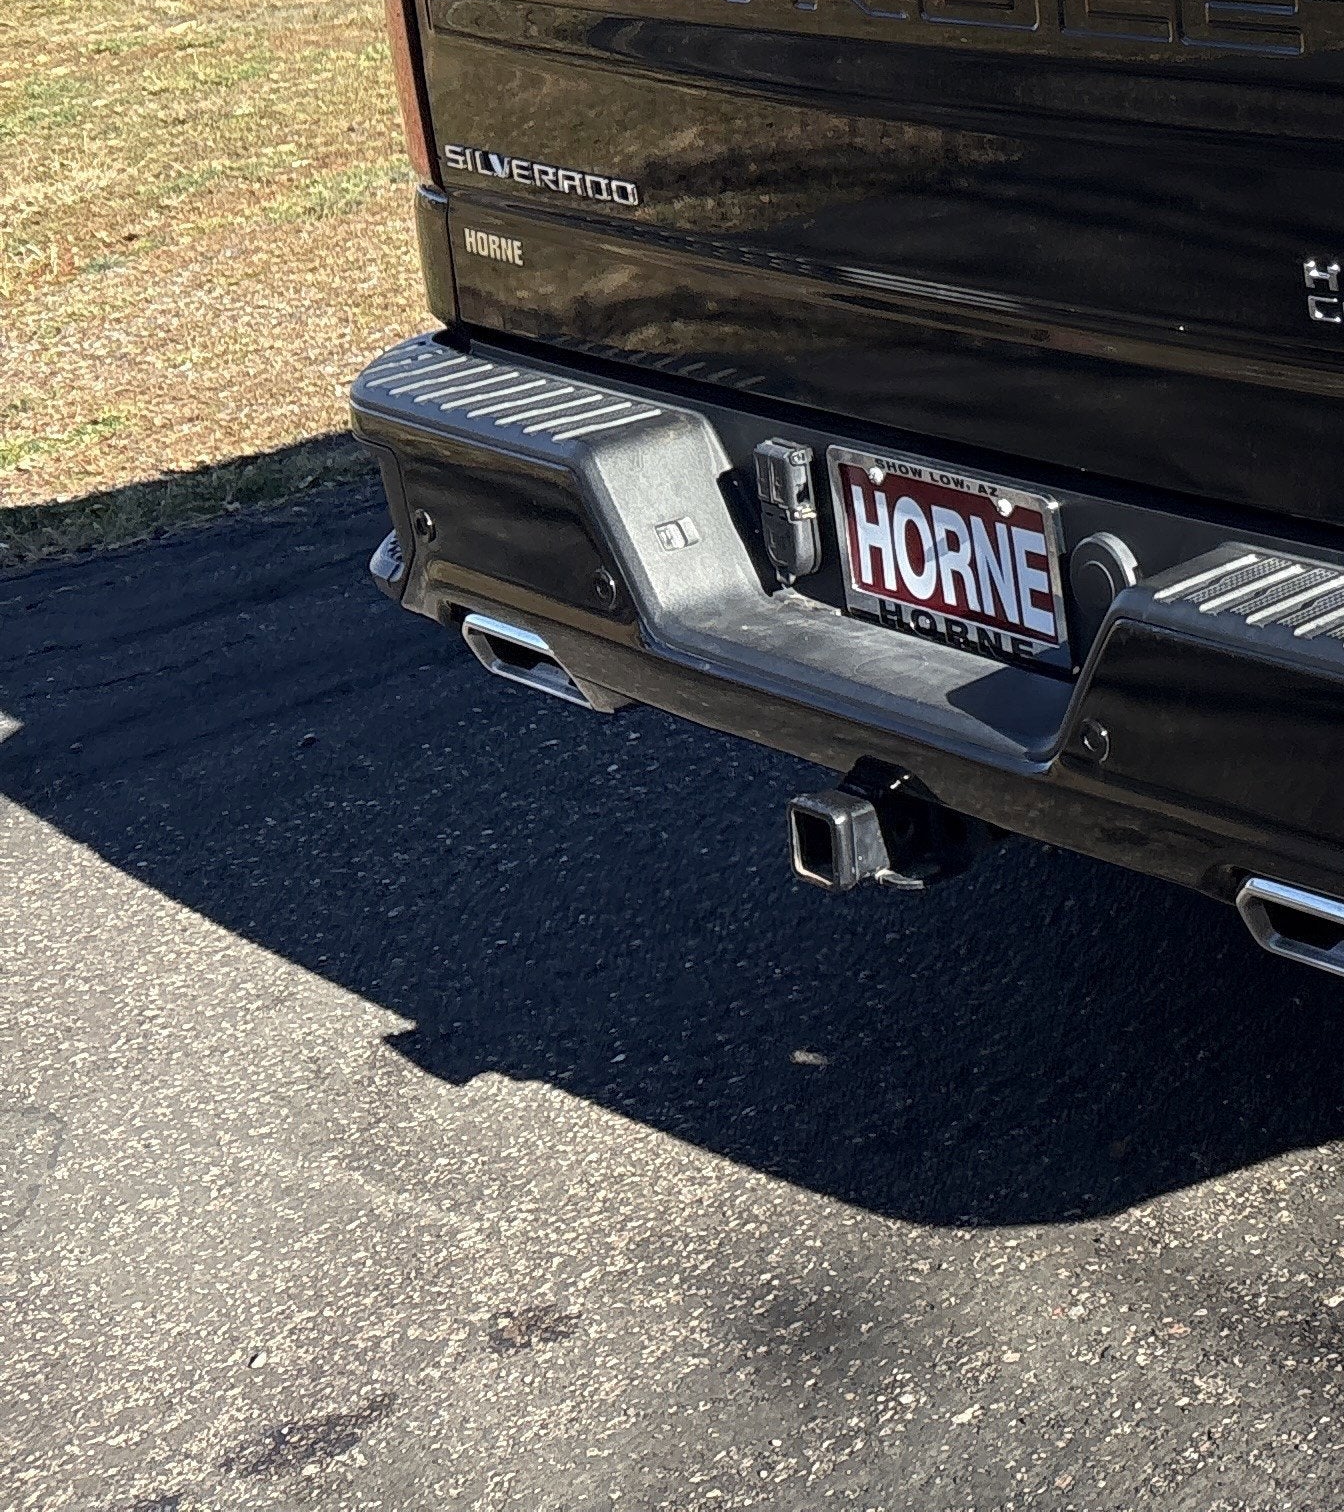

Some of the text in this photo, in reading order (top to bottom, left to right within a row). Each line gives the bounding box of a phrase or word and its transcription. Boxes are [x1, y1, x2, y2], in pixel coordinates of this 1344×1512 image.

[444, 144, 640, 206] SILVERADO
[464, 228, 524, 266] HORNE
[874, 459, 923, 478] SHOW
[977, 484, 999, 498] AZ
[851, 485, 1055, 636] HORNE
[878, 598, 1035, 661] HORNE
